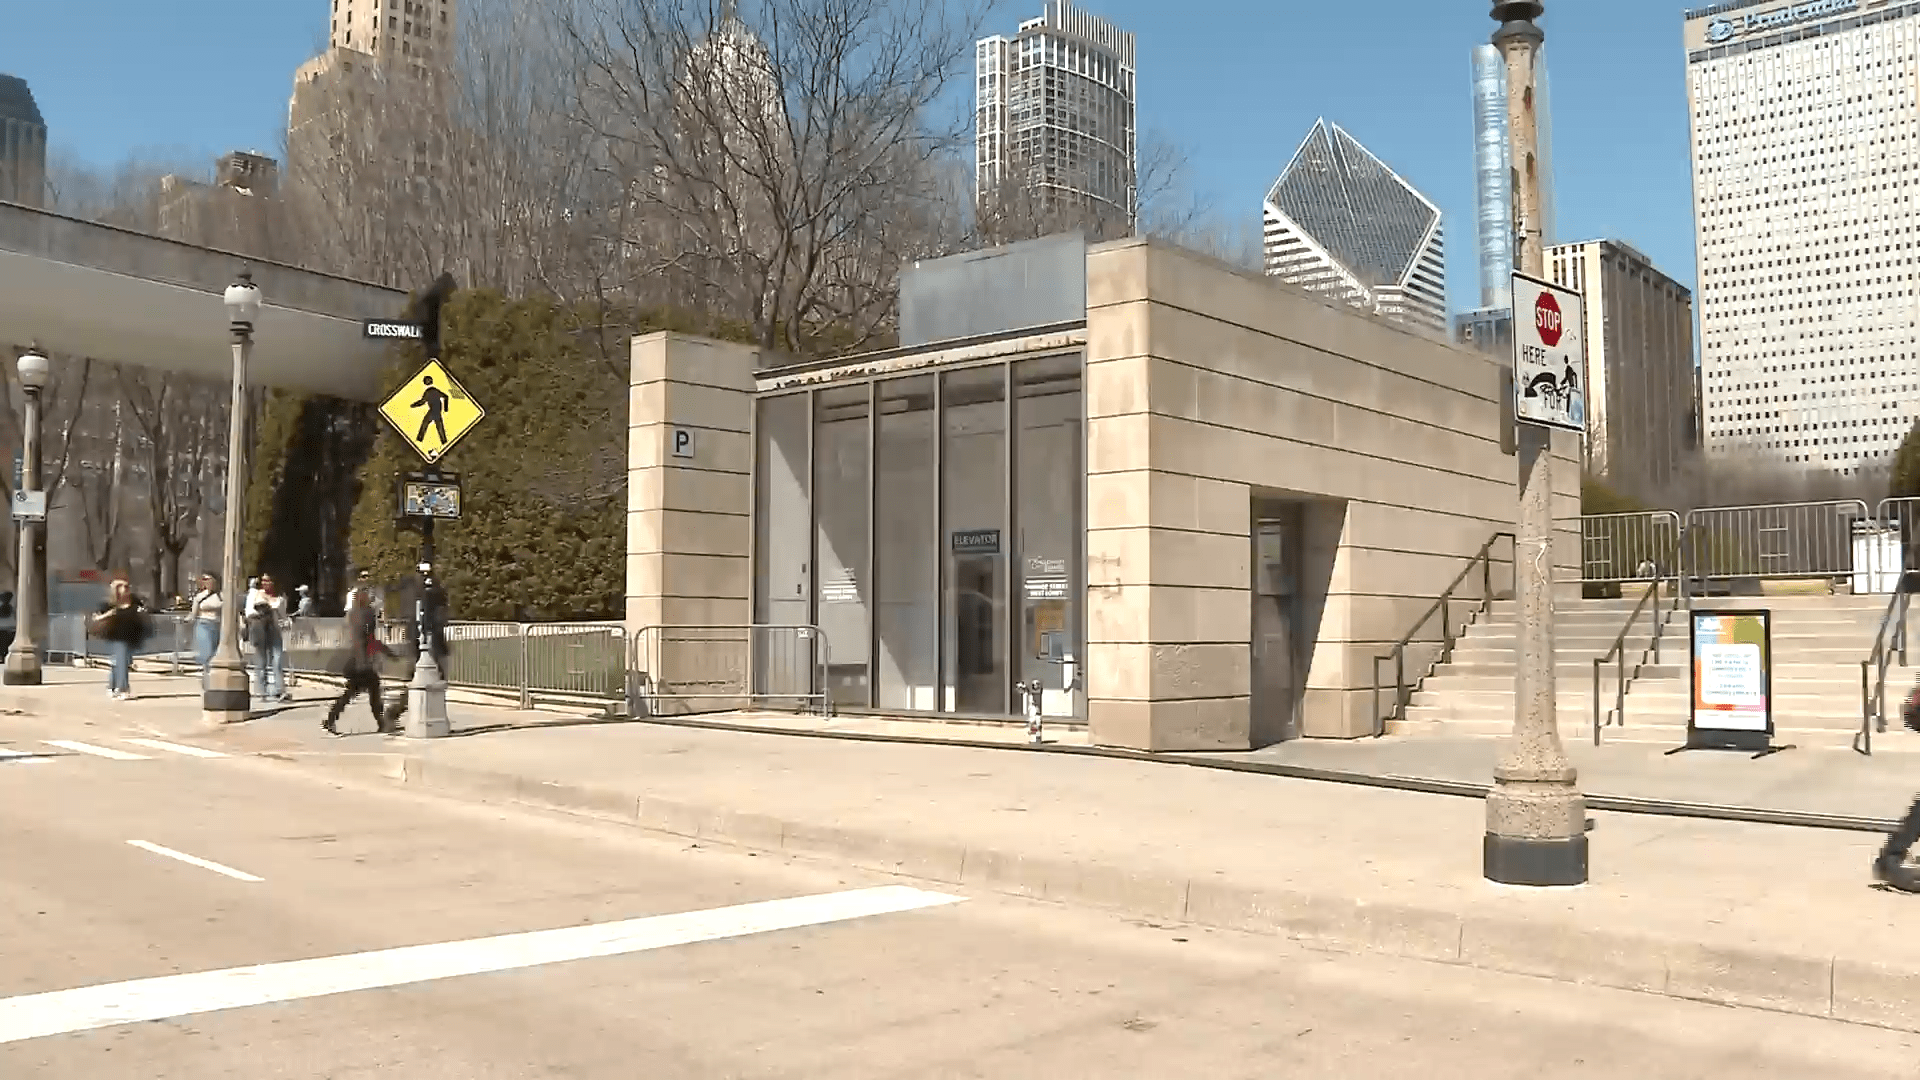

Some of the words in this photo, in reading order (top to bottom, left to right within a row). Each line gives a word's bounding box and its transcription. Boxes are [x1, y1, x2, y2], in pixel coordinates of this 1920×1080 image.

[1536, 306, 1560, 332] STOP
[1522, 344, 1547, 366] HERE
[676, 430, 689, 452] P
[954, 534, 997, 545] ELEVATOR
